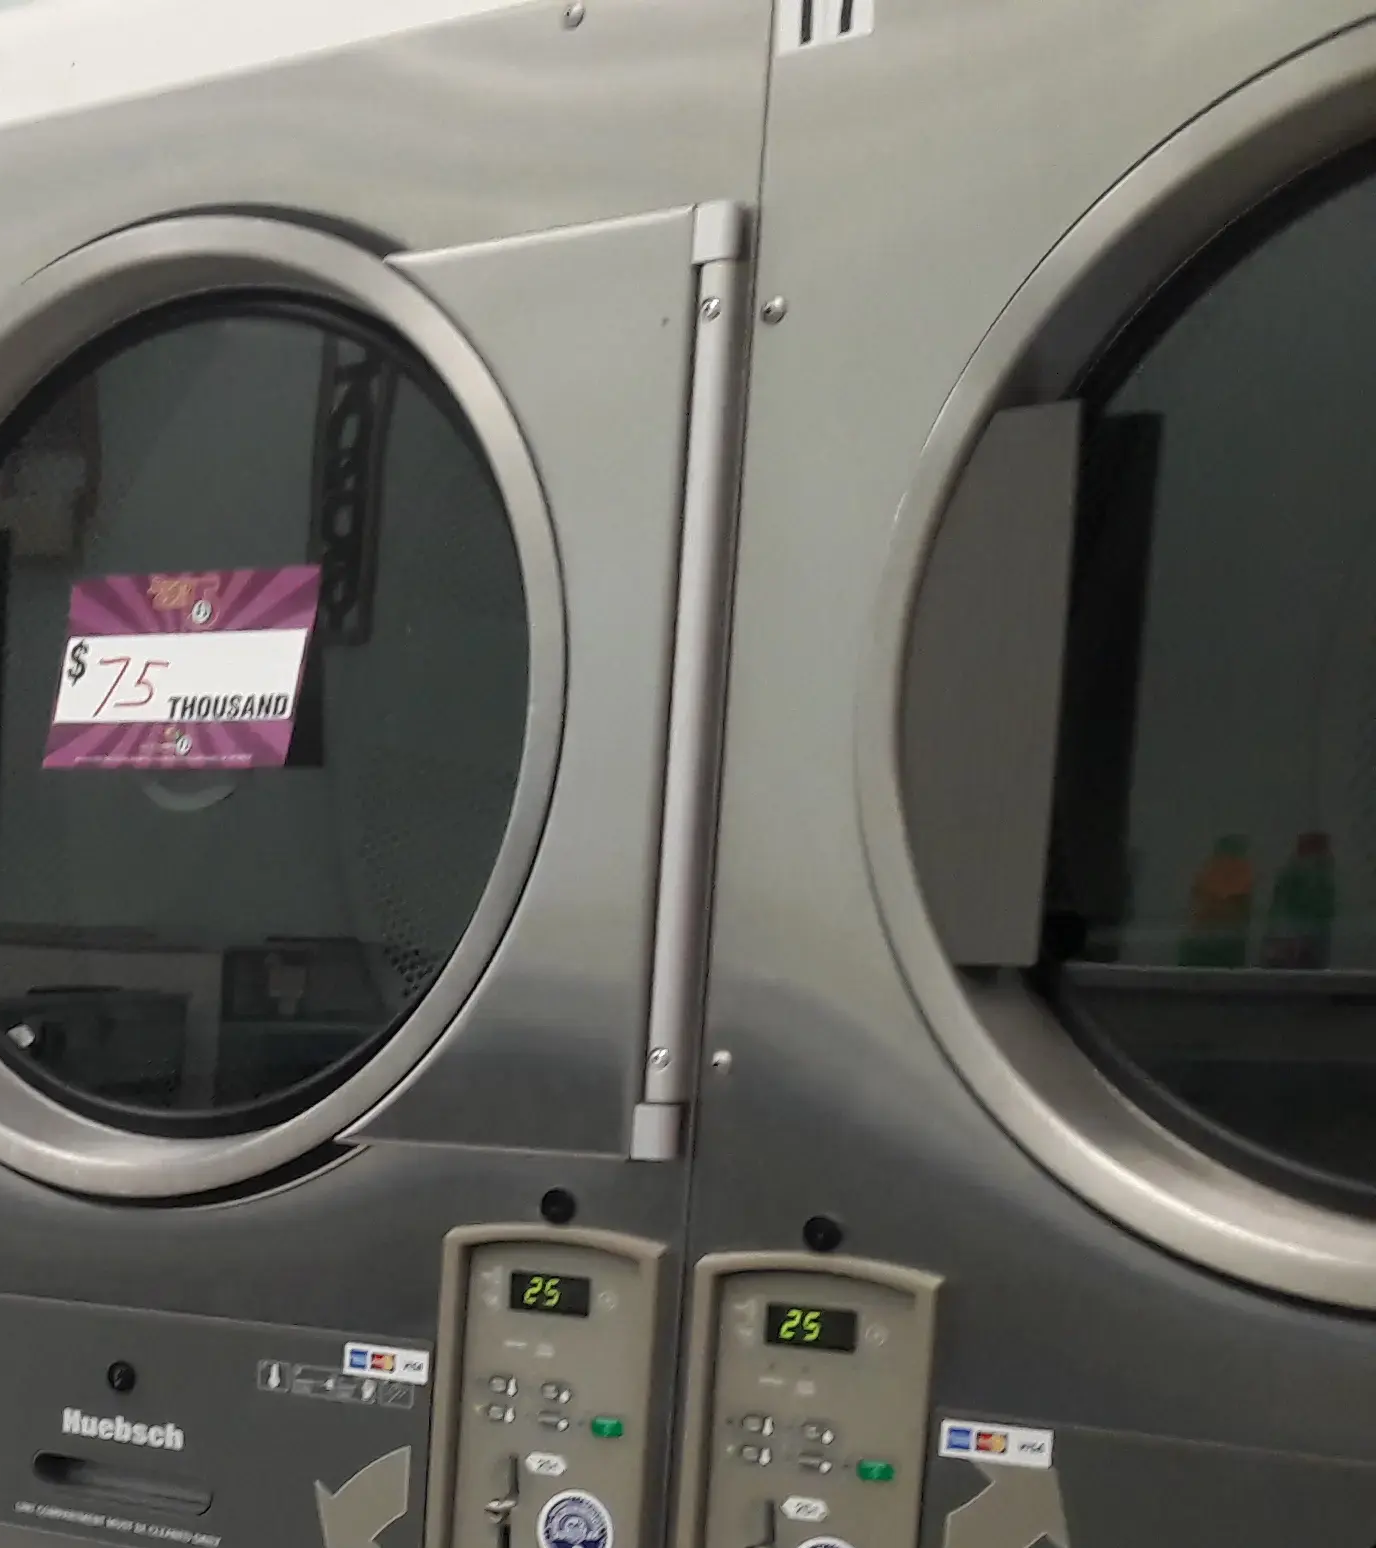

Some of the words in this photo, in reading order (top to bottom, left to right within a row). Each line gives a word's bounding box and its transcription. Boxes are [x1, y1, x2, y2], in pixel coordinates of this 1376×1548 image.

[168, 692, 289, 721] THOUSAND
[523, 1276, 562, 1307] 25
[778, 1309, 822, 1341] 25
[61, 1406, 186, 1451] Huebsch
